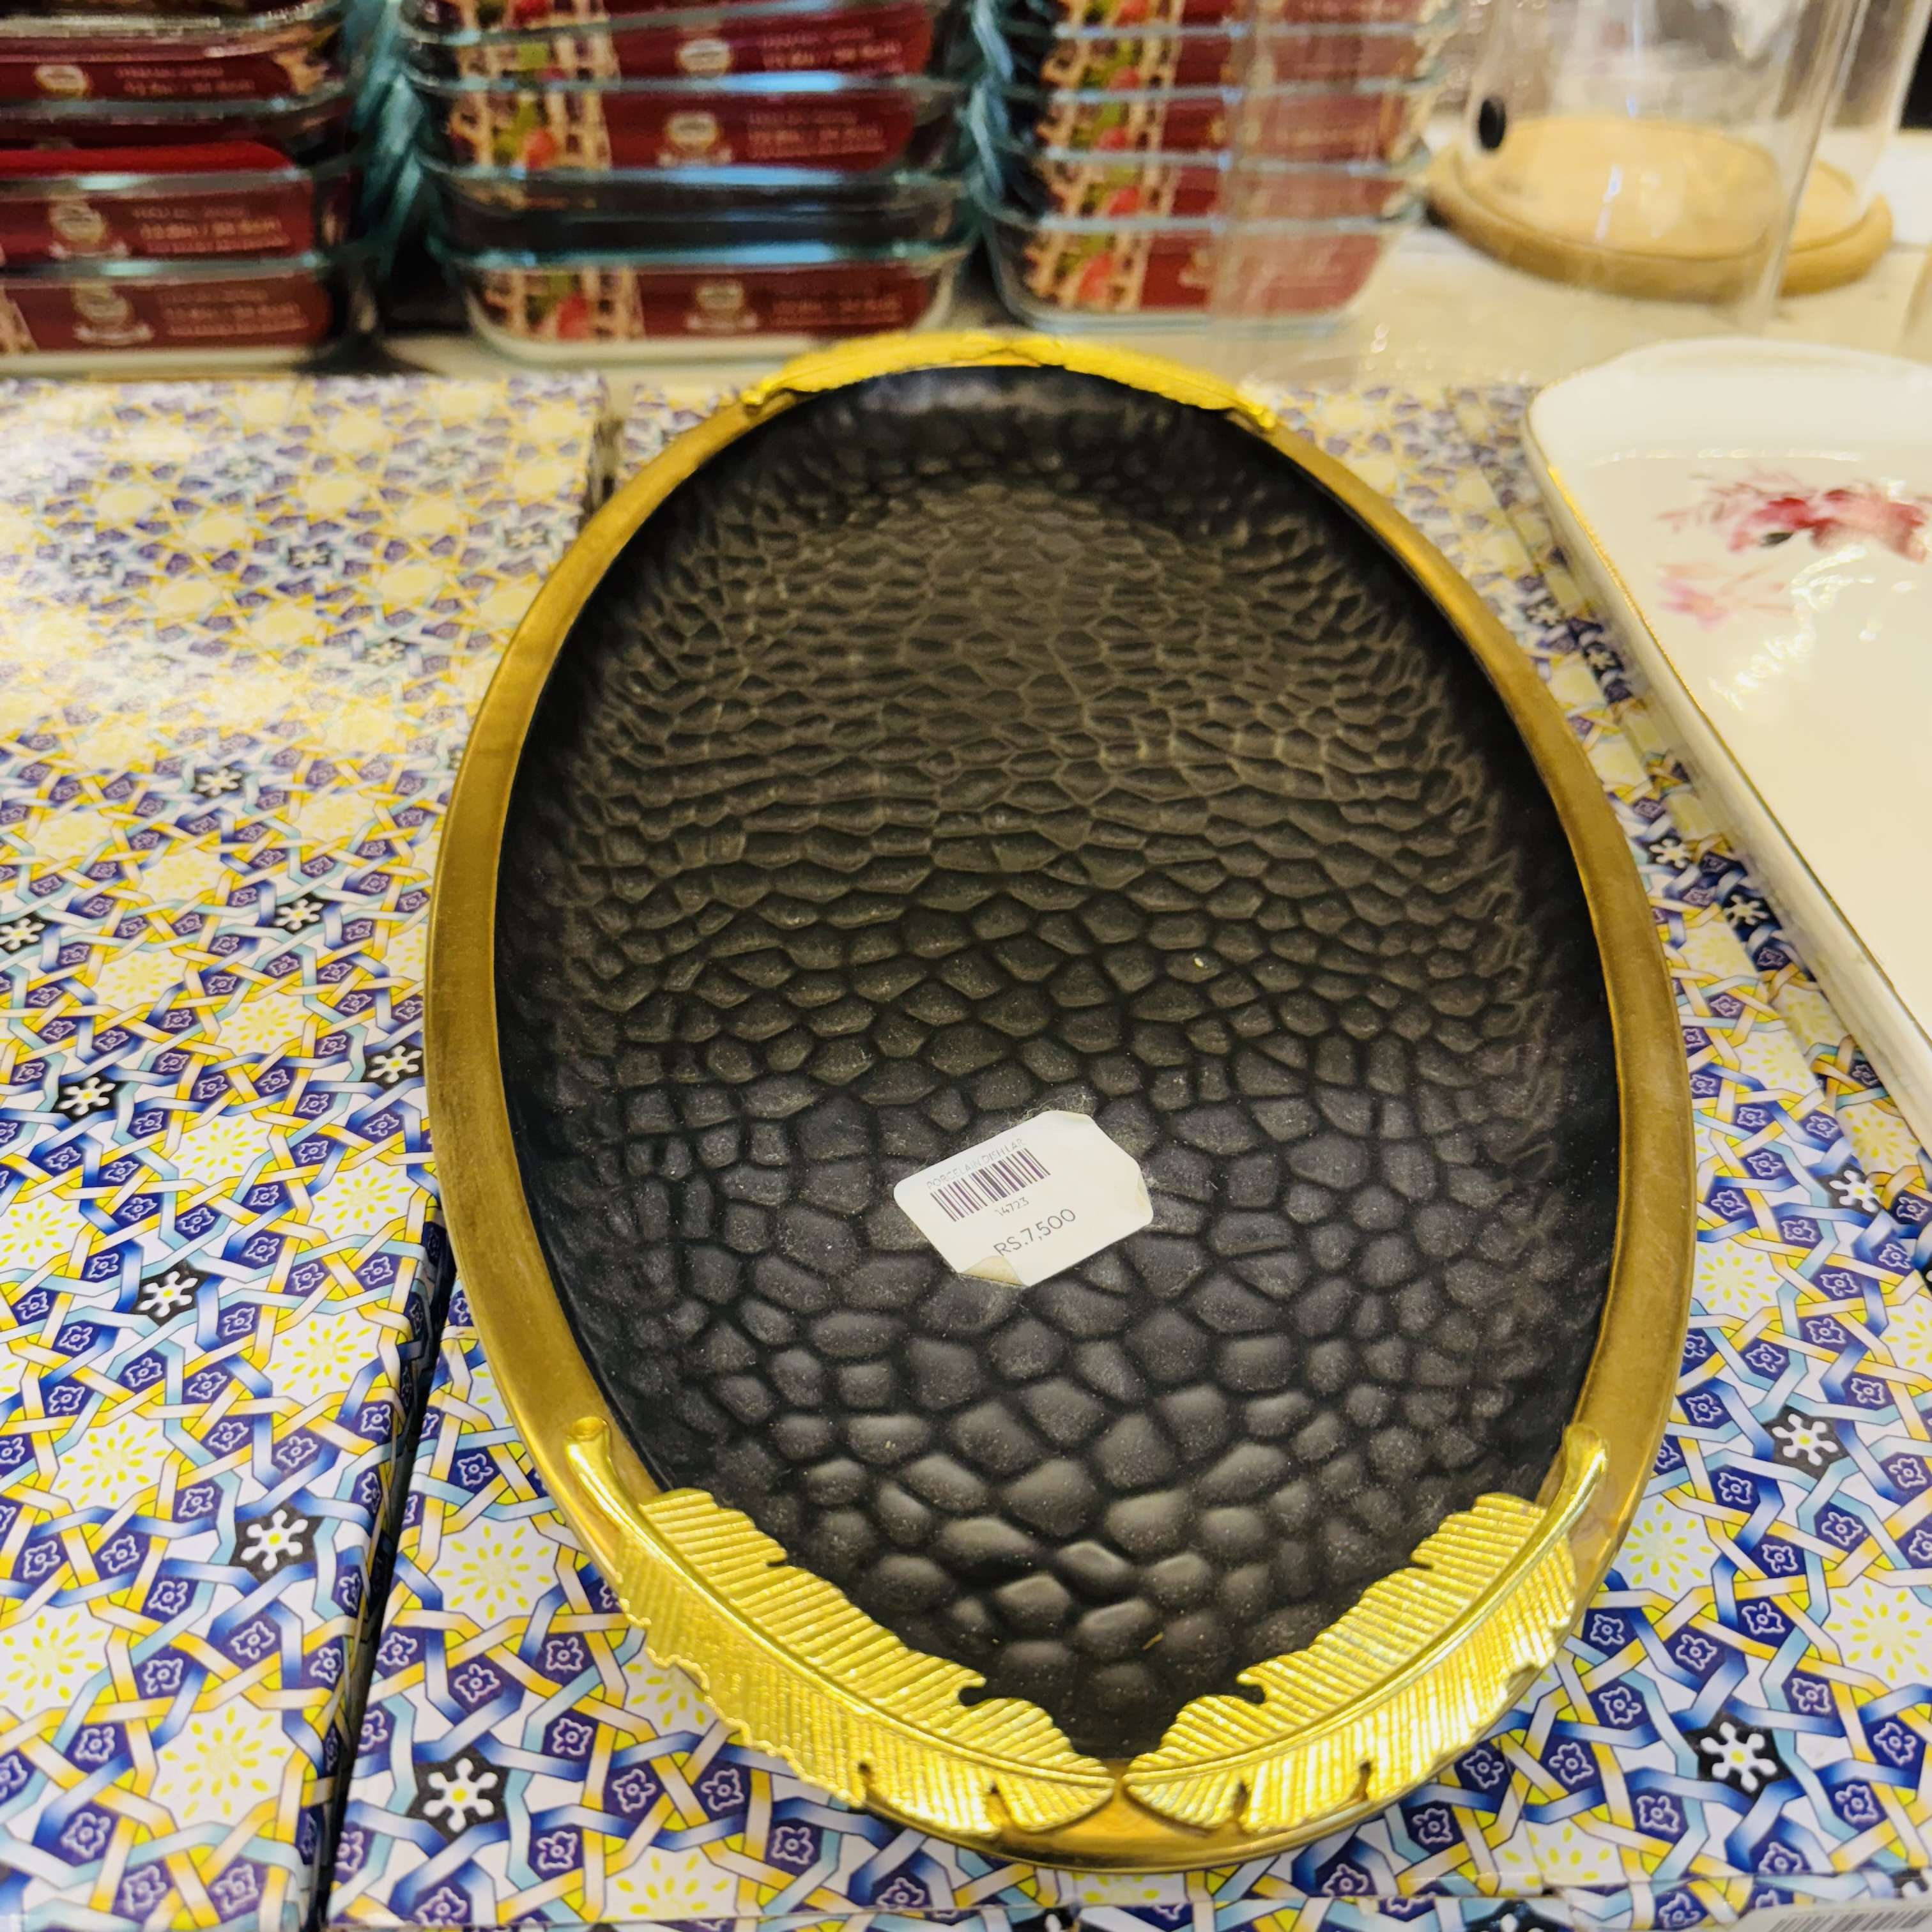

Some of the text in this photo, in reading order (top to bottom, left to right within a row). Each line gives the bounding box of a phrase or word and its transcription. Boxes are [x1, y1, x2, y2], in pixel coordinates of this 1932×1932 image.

[926, 1159, 982, 1188] PORCELAIN
[994, 1197, 1029, 1216] 14723
[993, 1209, 1076, 1256] RS.7,500
